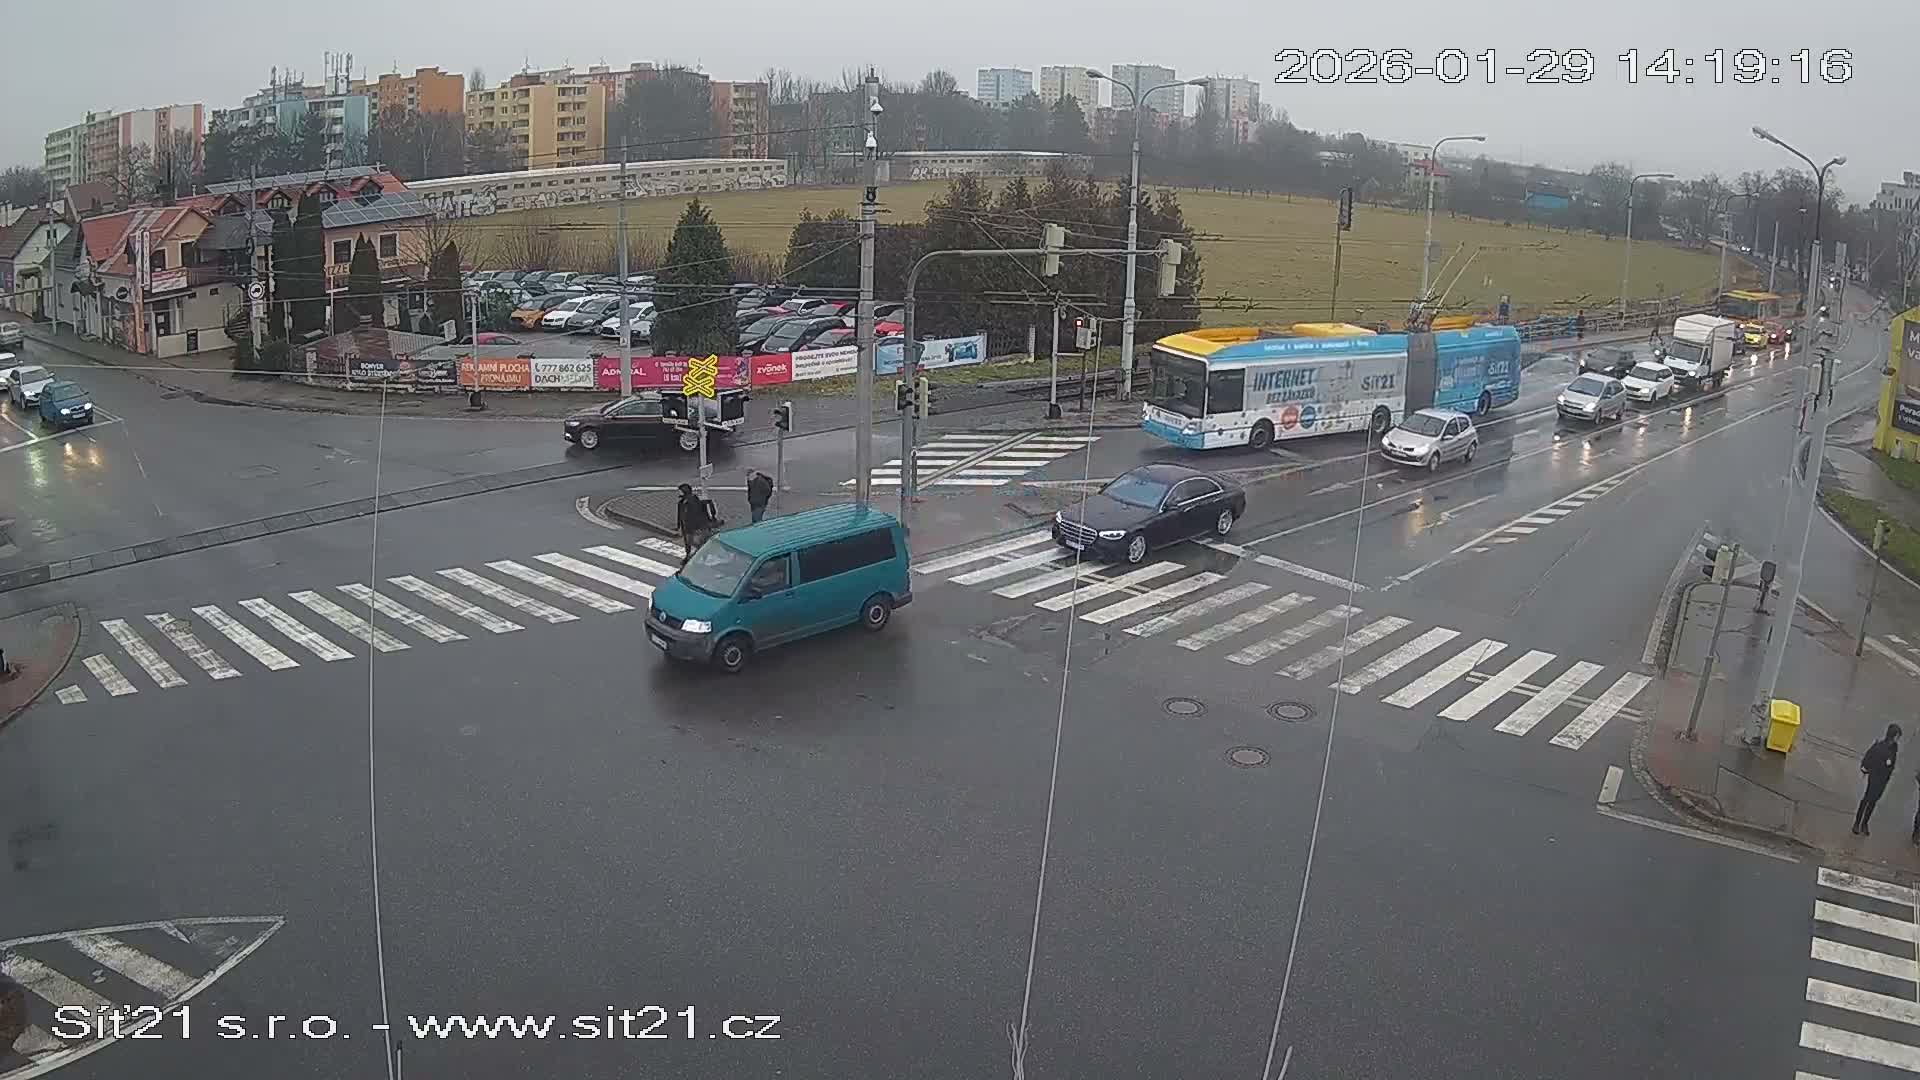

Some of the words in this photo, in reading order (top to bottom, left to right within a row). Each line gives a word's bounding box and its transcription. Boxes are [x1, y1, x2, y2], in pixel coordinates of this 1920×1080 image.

[541, 364, 558, 373] 777
[558, 363, 575, 373] 862
[575, 363, 592, 373] 625
[1253, 367, 1317, 392] INTERNET
